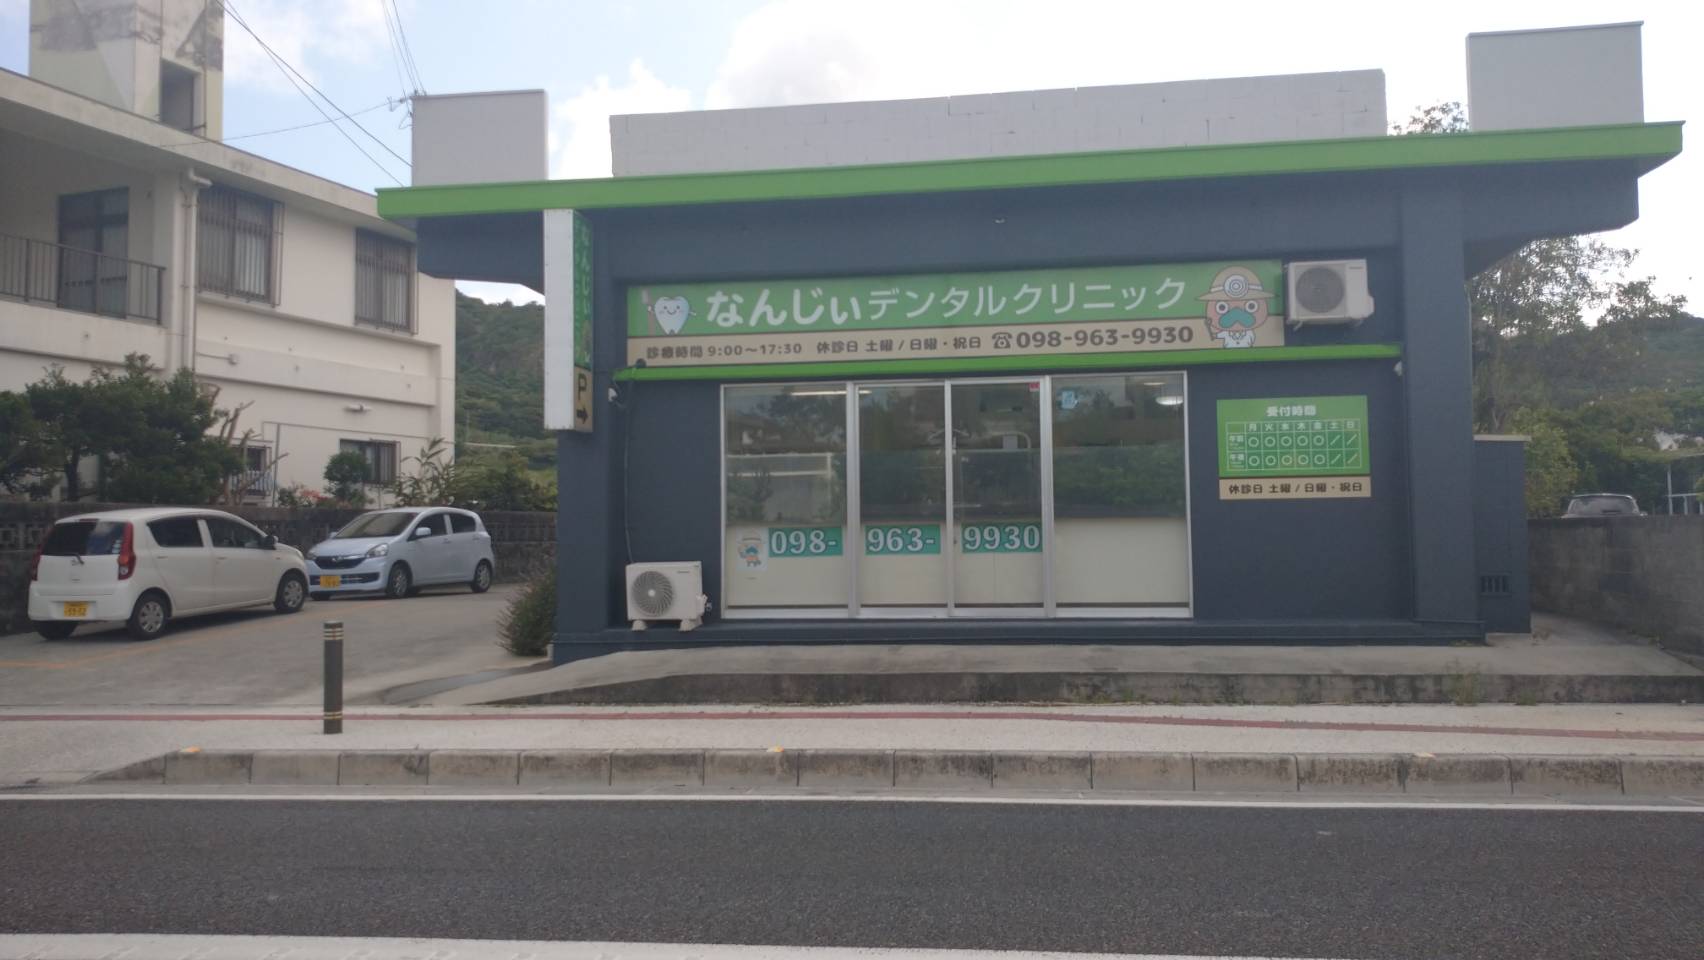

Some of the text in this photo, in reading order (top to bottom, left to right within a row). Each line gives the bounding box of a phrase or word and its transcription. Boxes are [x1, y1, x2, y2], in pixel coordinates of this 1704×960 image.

[706, 278, 1186, 327] なんじいデンタルクリニック
[817, 340, 859, 354] 休診日
[1016, 325, 1194, 349] 098-963-9930
[578, 373, 588, 400] P
[1229, 484, 1263, 495] 休診日
[771, 525, 1041, 554] 098- 963- 9930
